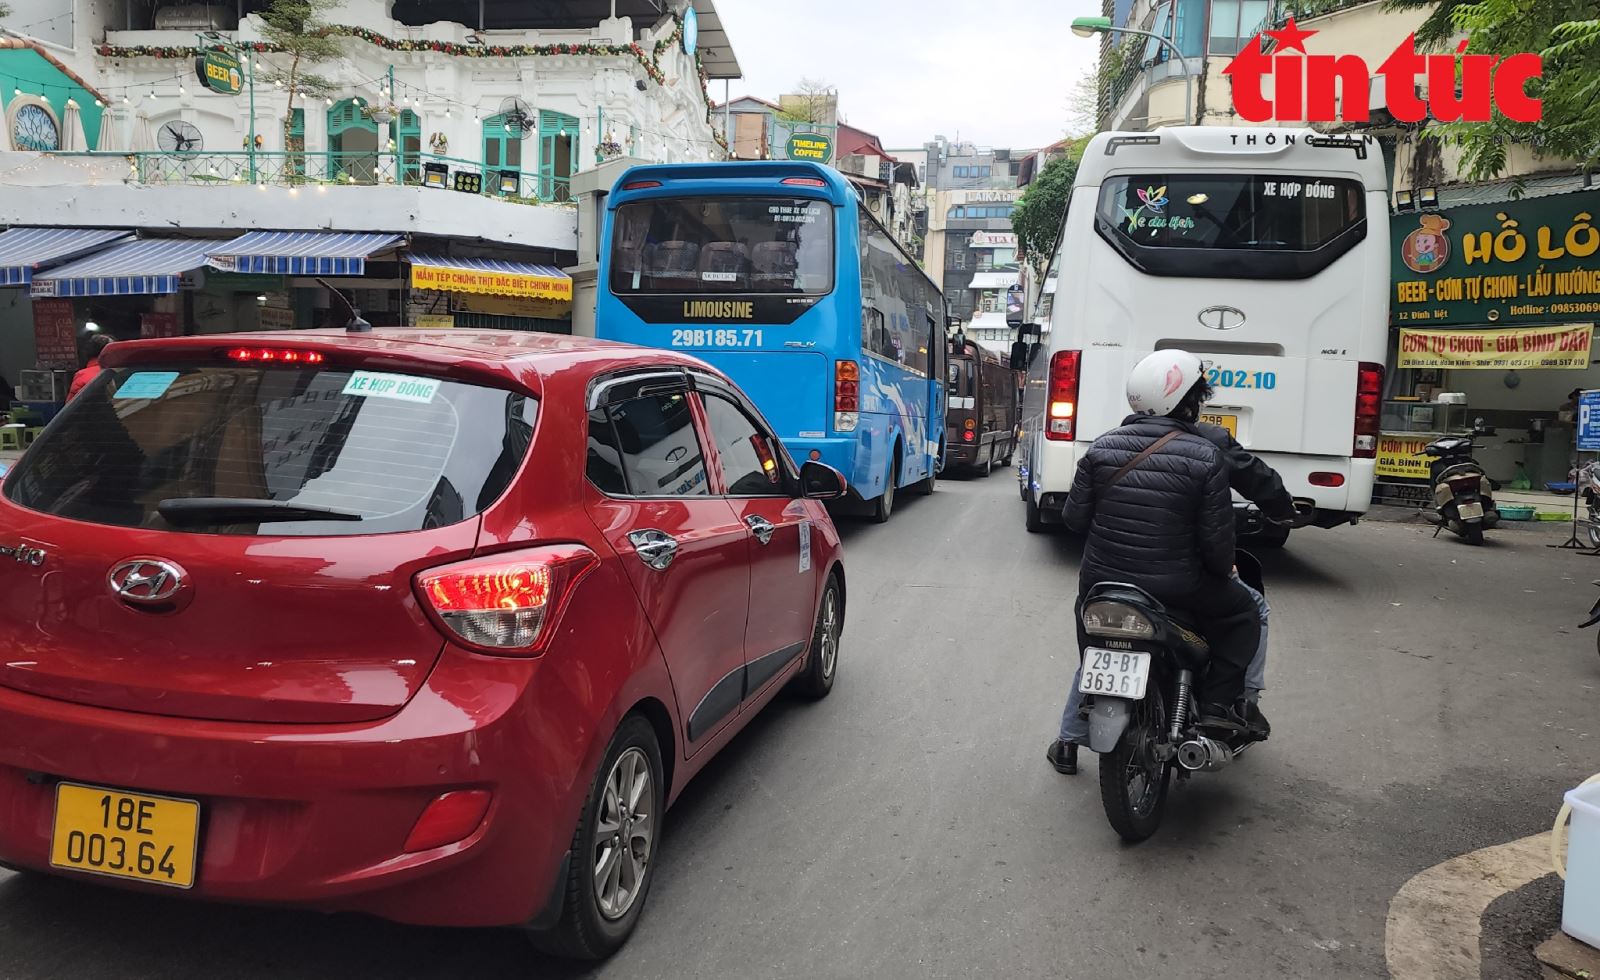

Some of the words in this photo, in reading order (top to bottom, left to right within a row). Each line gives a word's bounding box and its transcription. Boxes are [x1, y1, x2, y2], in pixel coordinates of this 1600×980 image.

[207, 63, 230, 82] BEER
[792, 139, 828, 149] TIMELINE
[794, 148, 824, 158] COFFEE
[967, 191, 1001, 202] LAIKA
[1264, 182, 1277, 196] XE
[1280, 182, 1302, 199] HỢP
[1463, 213, 1526, 265] HỒ
[1537, 212, 1600, 260] LÔ
[436, 271, 451, 282] TÉP
[478, 276, 493, 287] THỊT
[512, 277, 528, 290] BIỆT
[551, 283, 569, 292] MINH
[1398, 281, 1427, 303] BEER
[1436, 277, 1462, 301] CƠM
[1465, 275, 1482, 304] TỰ
[1484, 274, 1517, 303] CHỌN
[1527, 264, 1552, 297] LẨU
[683, 301, 753, 319] LIMOUSINE
[1399, 311, 1408, 320] 12
[671, 329, 763, 347] 29B185.71
[1402, 334, 1428, 352] CƠM
[1449, 336, 1484, 357] CHỌN
[1496, 330, 1519, 352] GIÁ
[1523, 330, 1556, 352] BÌNH
[350, 377, 369, 390] XE
[1579, 404, 1591, 436] P
[1381, 438, 1402, 454] CƠM
[1380, 457, 1396, 466] GIÁ
[1398, 457, 1421, 468] BÌNH
[1105, 640, 1132, 650] YAMAHA
[1092, 651, 1139, 674] 29-B1
[1084, 671, 1142, 695] 363.61
[100, 795, 156, 835] 18E
[67, 830, 176, 879] 003.64
